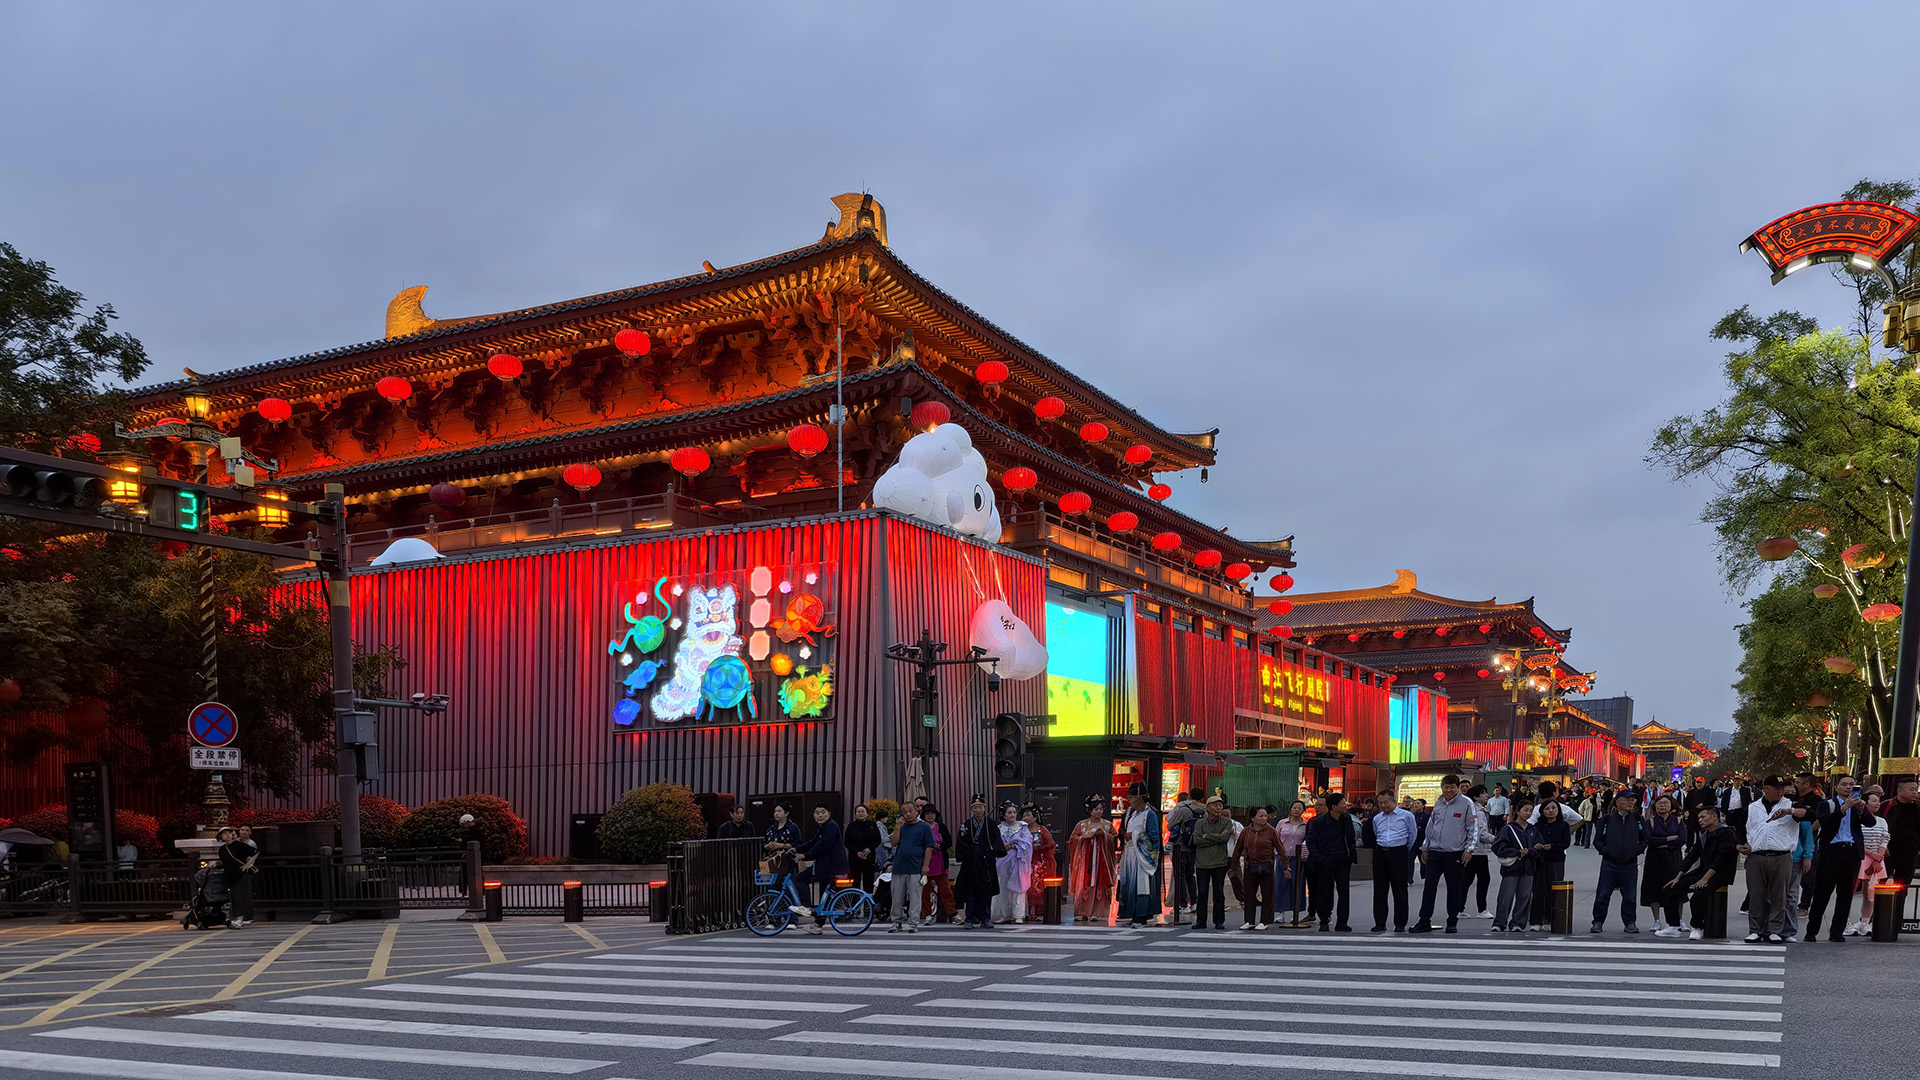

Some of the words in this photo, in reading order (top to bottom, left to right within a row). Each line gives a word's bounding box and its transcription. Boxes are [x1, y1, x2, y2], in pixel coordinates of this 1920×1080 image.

[1797, 218, 1873, 238] 大唐不夜城
[179, 492, 197, 530] 3
[194, 749, 238, 760] 全段禁停
